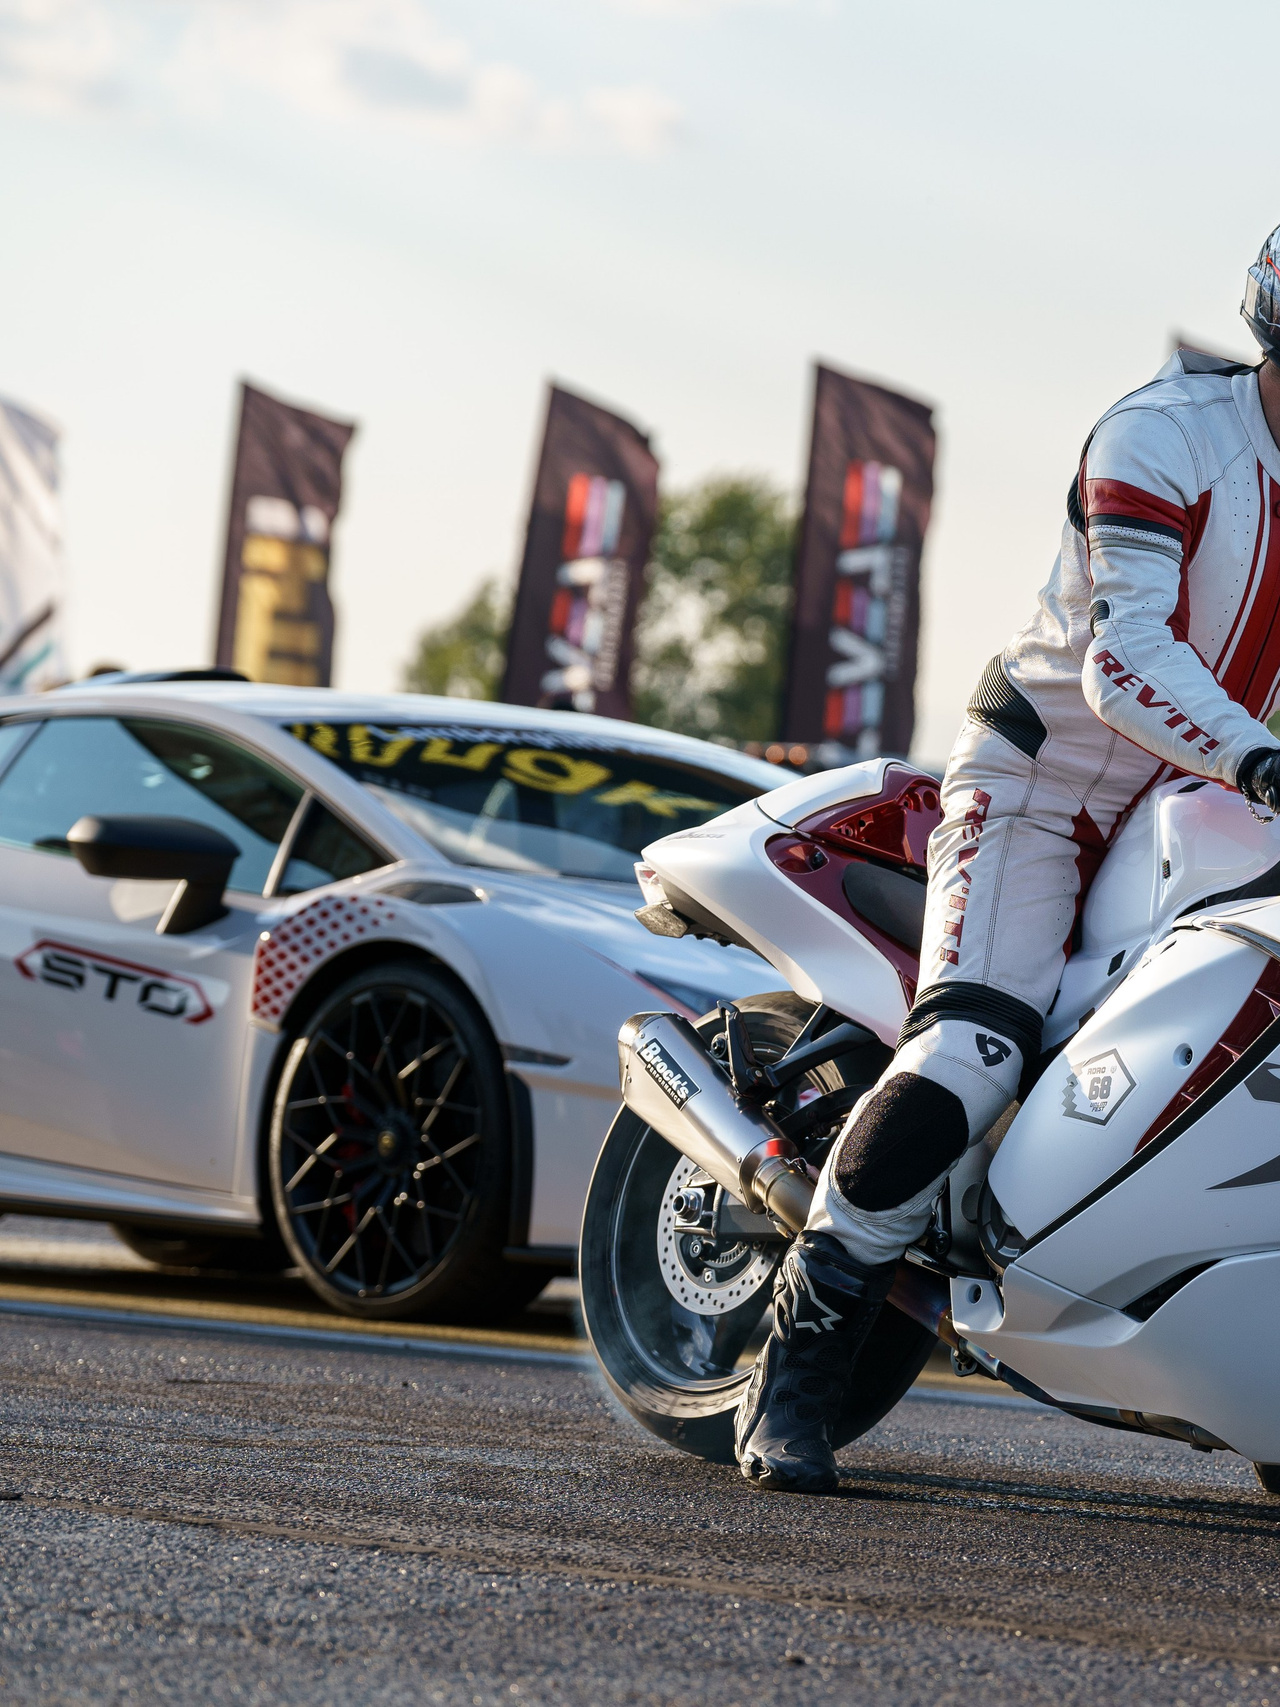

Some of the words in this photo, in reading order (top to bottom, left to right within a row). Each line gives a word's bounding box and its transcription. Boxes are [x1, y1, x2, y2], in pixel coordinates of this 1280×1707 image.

[41, 951, 190, 1018] STO
[640, 1041, 690, 1099] Brock's
[646, 1063, 681, 1105] PERFORMANCE
[1088, 1075, 1112, 1100] 68
